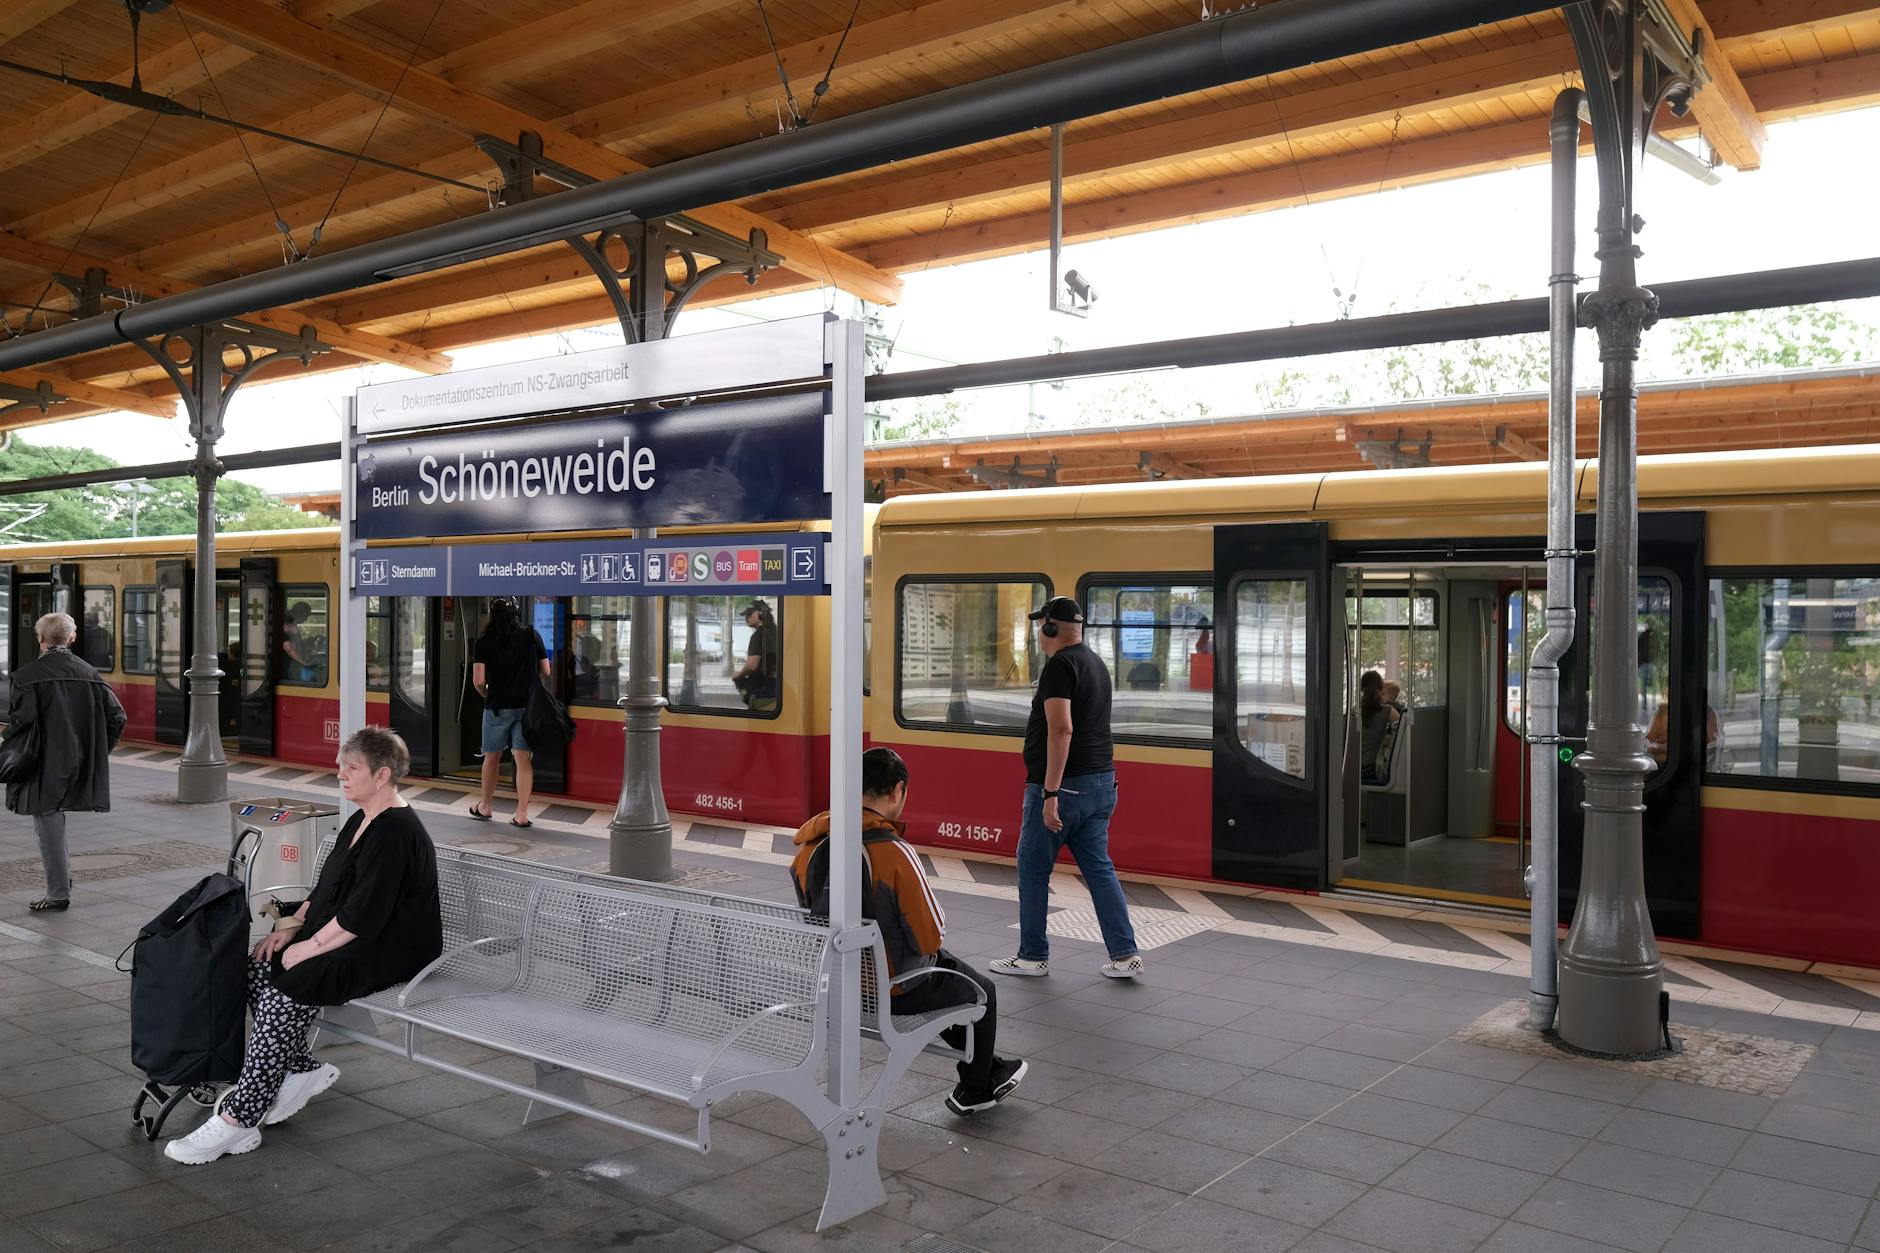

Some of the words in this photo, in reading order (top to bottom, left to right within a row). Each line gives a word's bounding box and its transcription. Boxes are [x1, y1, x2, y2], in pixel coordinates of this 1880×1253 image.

[402, 380, 524, 410] Dokumentationszentrum
[527, 362, 629, 393] NS-Zwangsarbeit
[372, 486, 409, 508] Berlin
[418, 436, 656, 505] Schöneweide
[391, 565, 436, 579] Sterndamm
[479, 561, 577, 577] Michael-Brückner-Str.
[693, 553, 709, 580] S
[716, 561, 732, 572] BUS
[739, 560, 758, 571] Tram
[764, 559, 781, 571] TAXI
[325, 722, 340, 740] DB
[695, 793, 714, 807] 482
[716, 796, 743, 811] 456-1
[937, 822, 961, 838] 482
[965, 825, 1002, 843] 156-7
[283, 847, 297, 860] DB
